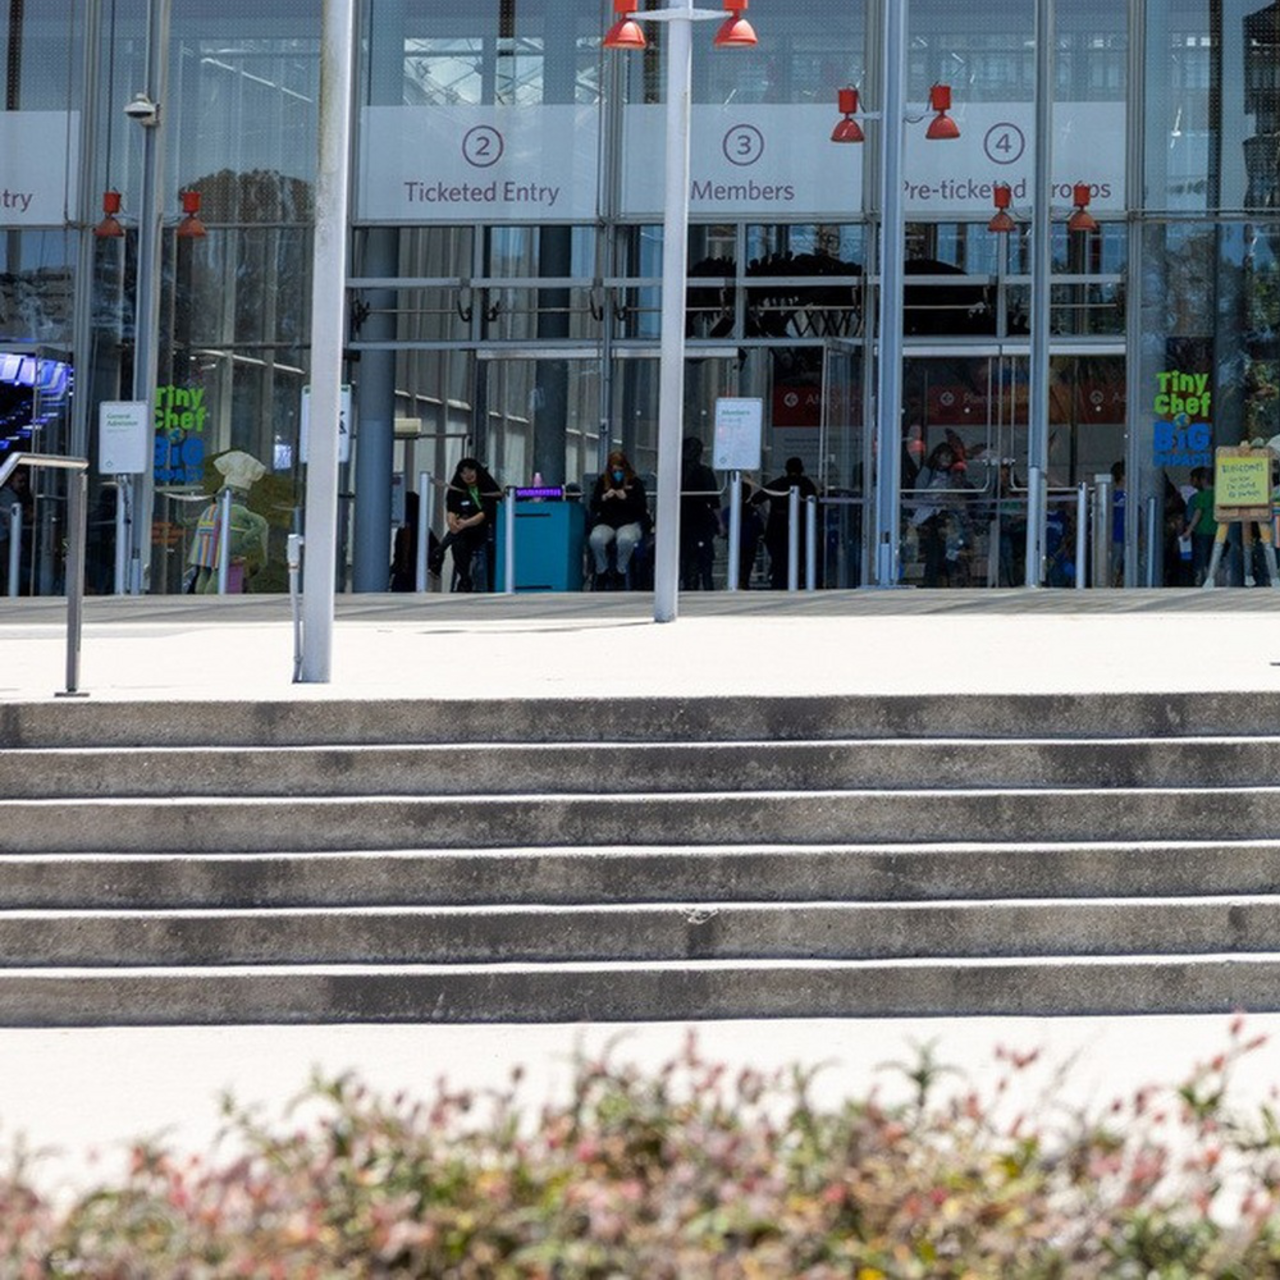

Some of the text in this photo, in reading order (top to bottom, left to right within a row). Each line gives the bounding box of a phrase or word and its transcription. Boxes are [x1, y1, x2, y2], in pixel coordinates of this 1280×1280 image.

[2, 189, 33, 212] try
[404, 181, 560, 206] Ticketed Entry
[691, 179, 795, 200] Members
[1156, 370, 1209, 396] Tiny
[1154, 392, 1211, 417] Chef
